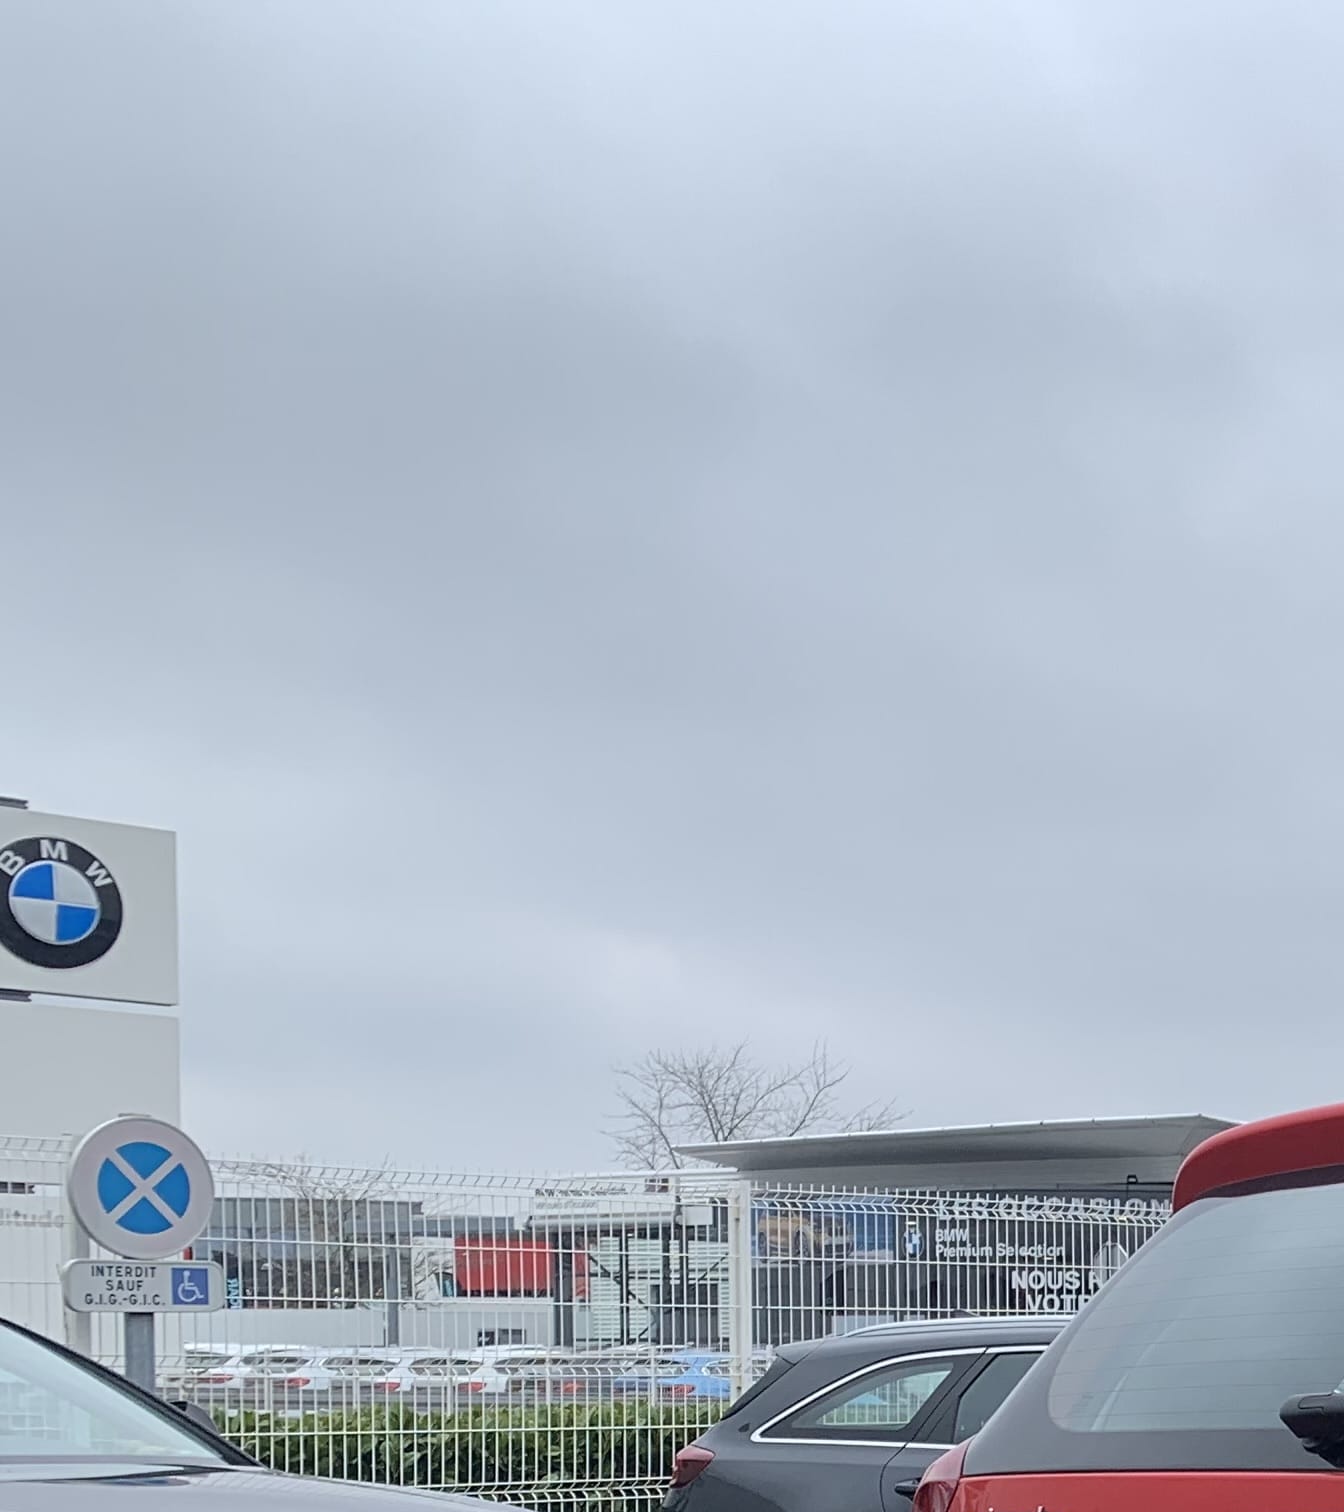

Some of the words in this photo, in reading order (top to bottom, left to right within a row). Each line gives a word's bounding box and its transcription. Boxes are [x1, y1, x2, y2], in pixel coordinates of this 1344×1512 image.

[0, 839, 113, 888] BMW
[935, 1228, 969, 1242] BMW
[935, 1243, 993, 1257] Premium
[996, 1242, 1064, 1257] Selection
[91, 1265, 157, 1278] INTERDIT
[105, 1280, 144, 1292] SAUF
[1011, 1270, 1081, 1290] NOUS
